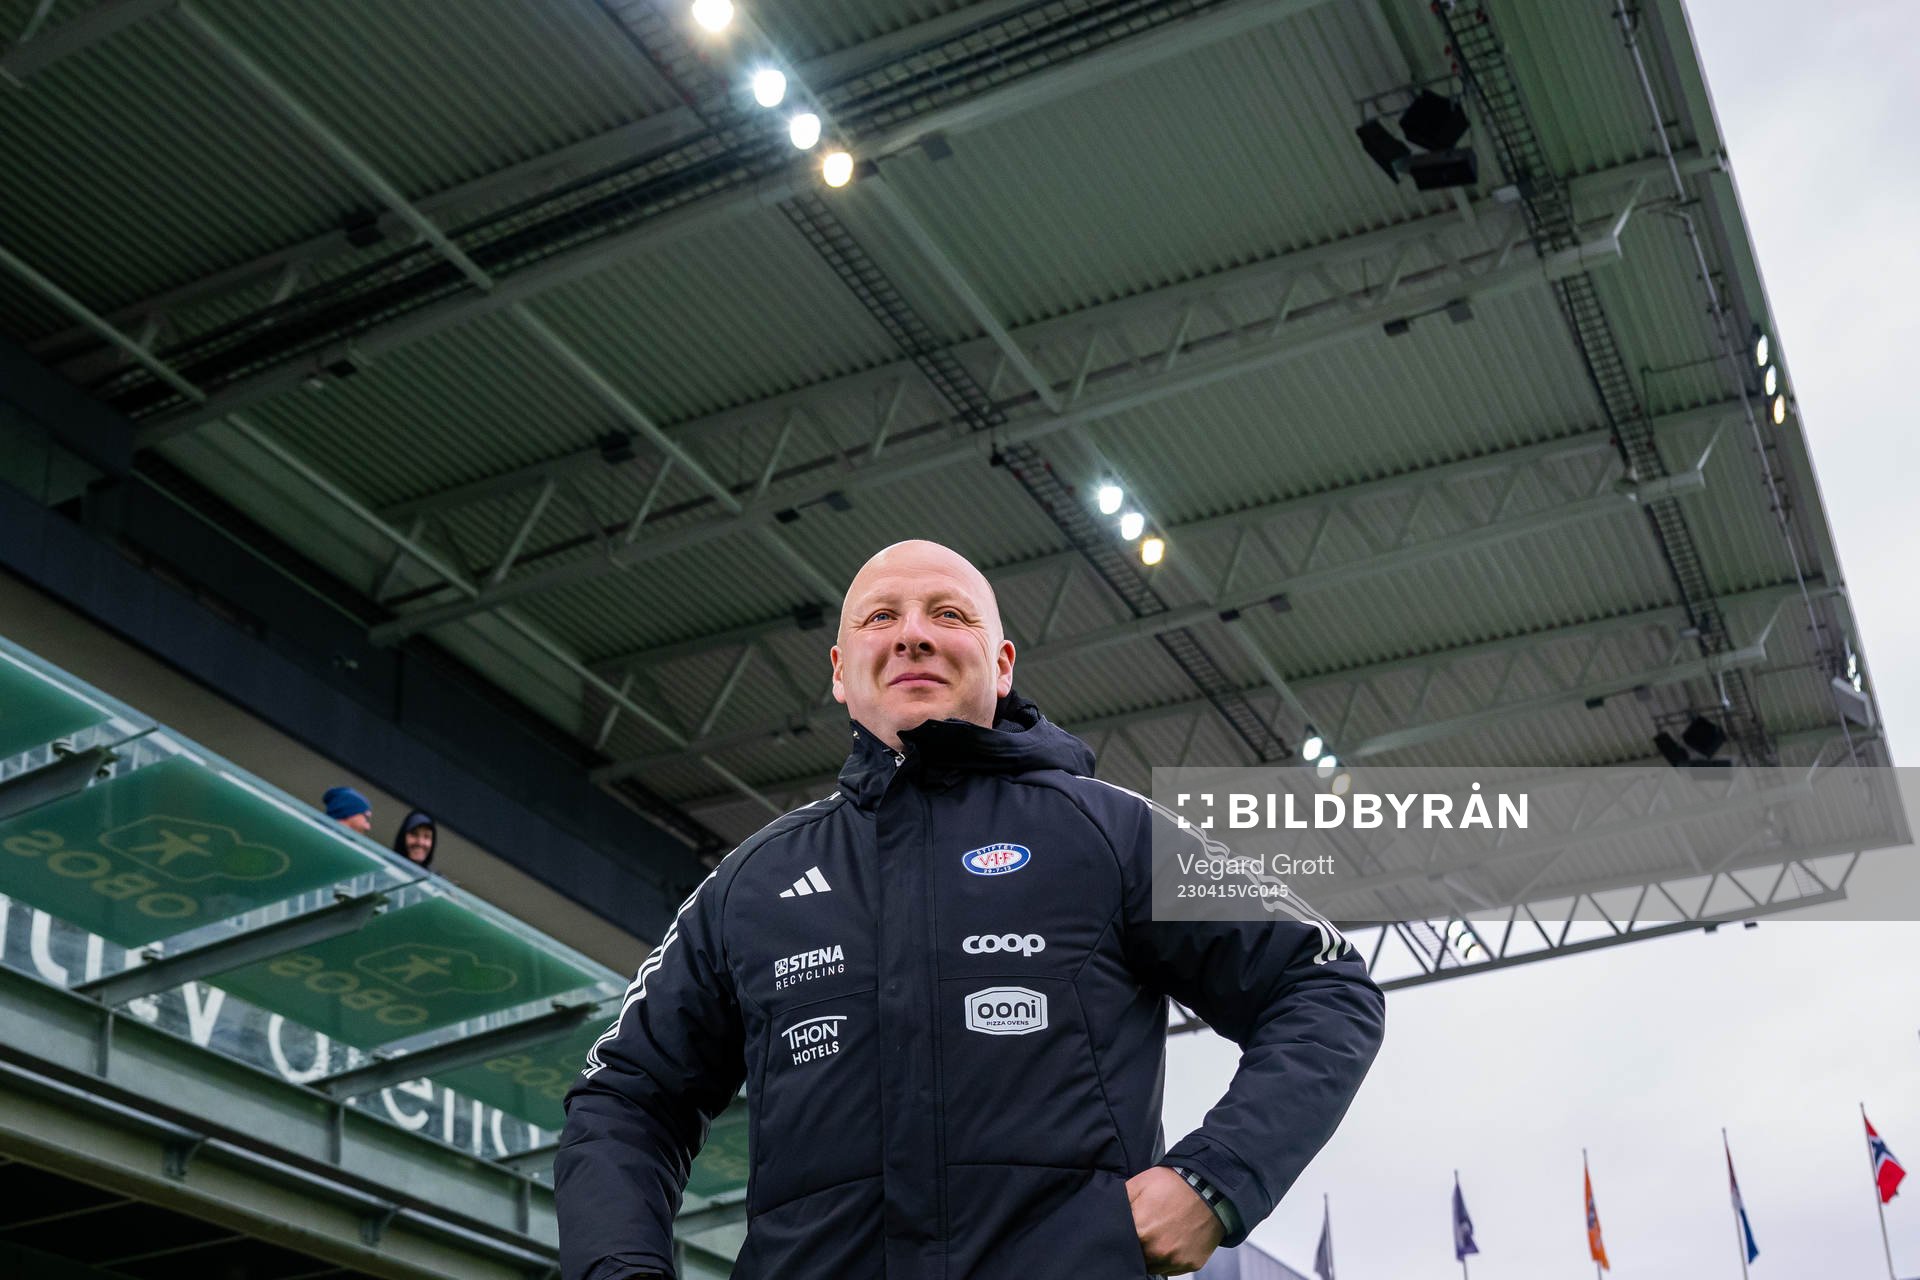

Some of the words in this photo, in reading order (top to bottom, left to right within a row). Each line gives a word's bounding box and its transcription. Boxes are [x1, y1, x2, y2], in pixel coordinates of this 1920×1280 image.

[962, 933, 1046, 957] coop
[789, 944, 845, 973] STENA
[775, 963, 845, 991] RECYCLING
[977, 999, 1036, 1019] ooni
[781, 1015, 847, 1050] THON
[792, 1041, 840, 1066] HOTELS
